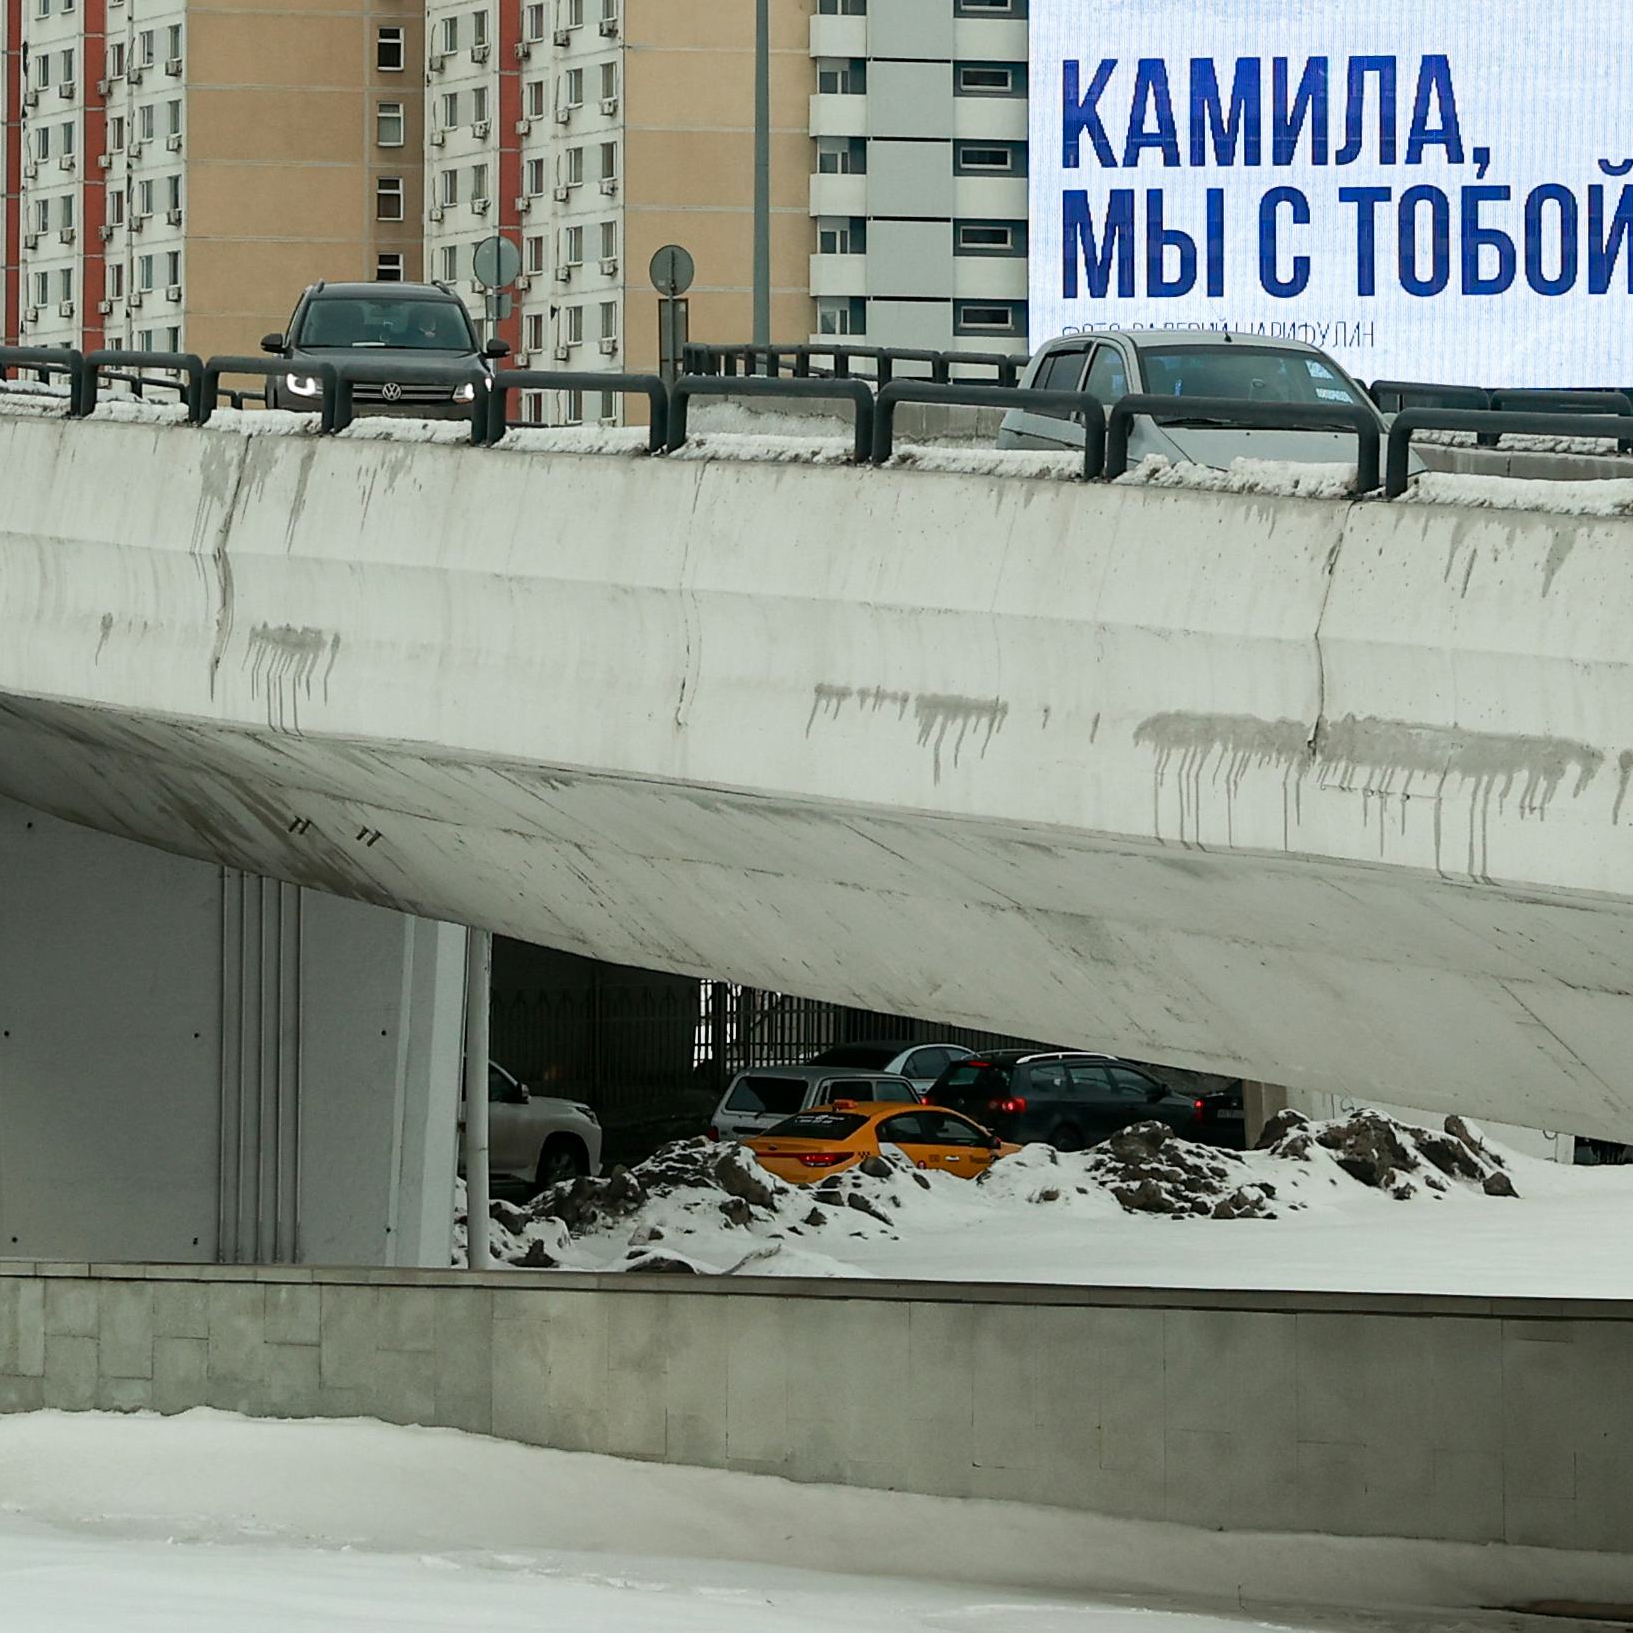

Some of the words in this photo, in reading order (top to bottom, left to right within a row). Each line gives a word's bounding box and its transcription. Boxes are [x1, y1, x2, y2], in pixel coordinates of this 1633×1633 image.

[1062, 53, 1491, 180] КАМИЛА,
[1062, 187, 1225, 299] МЫ
[1258, 185, 1311, 299] С
